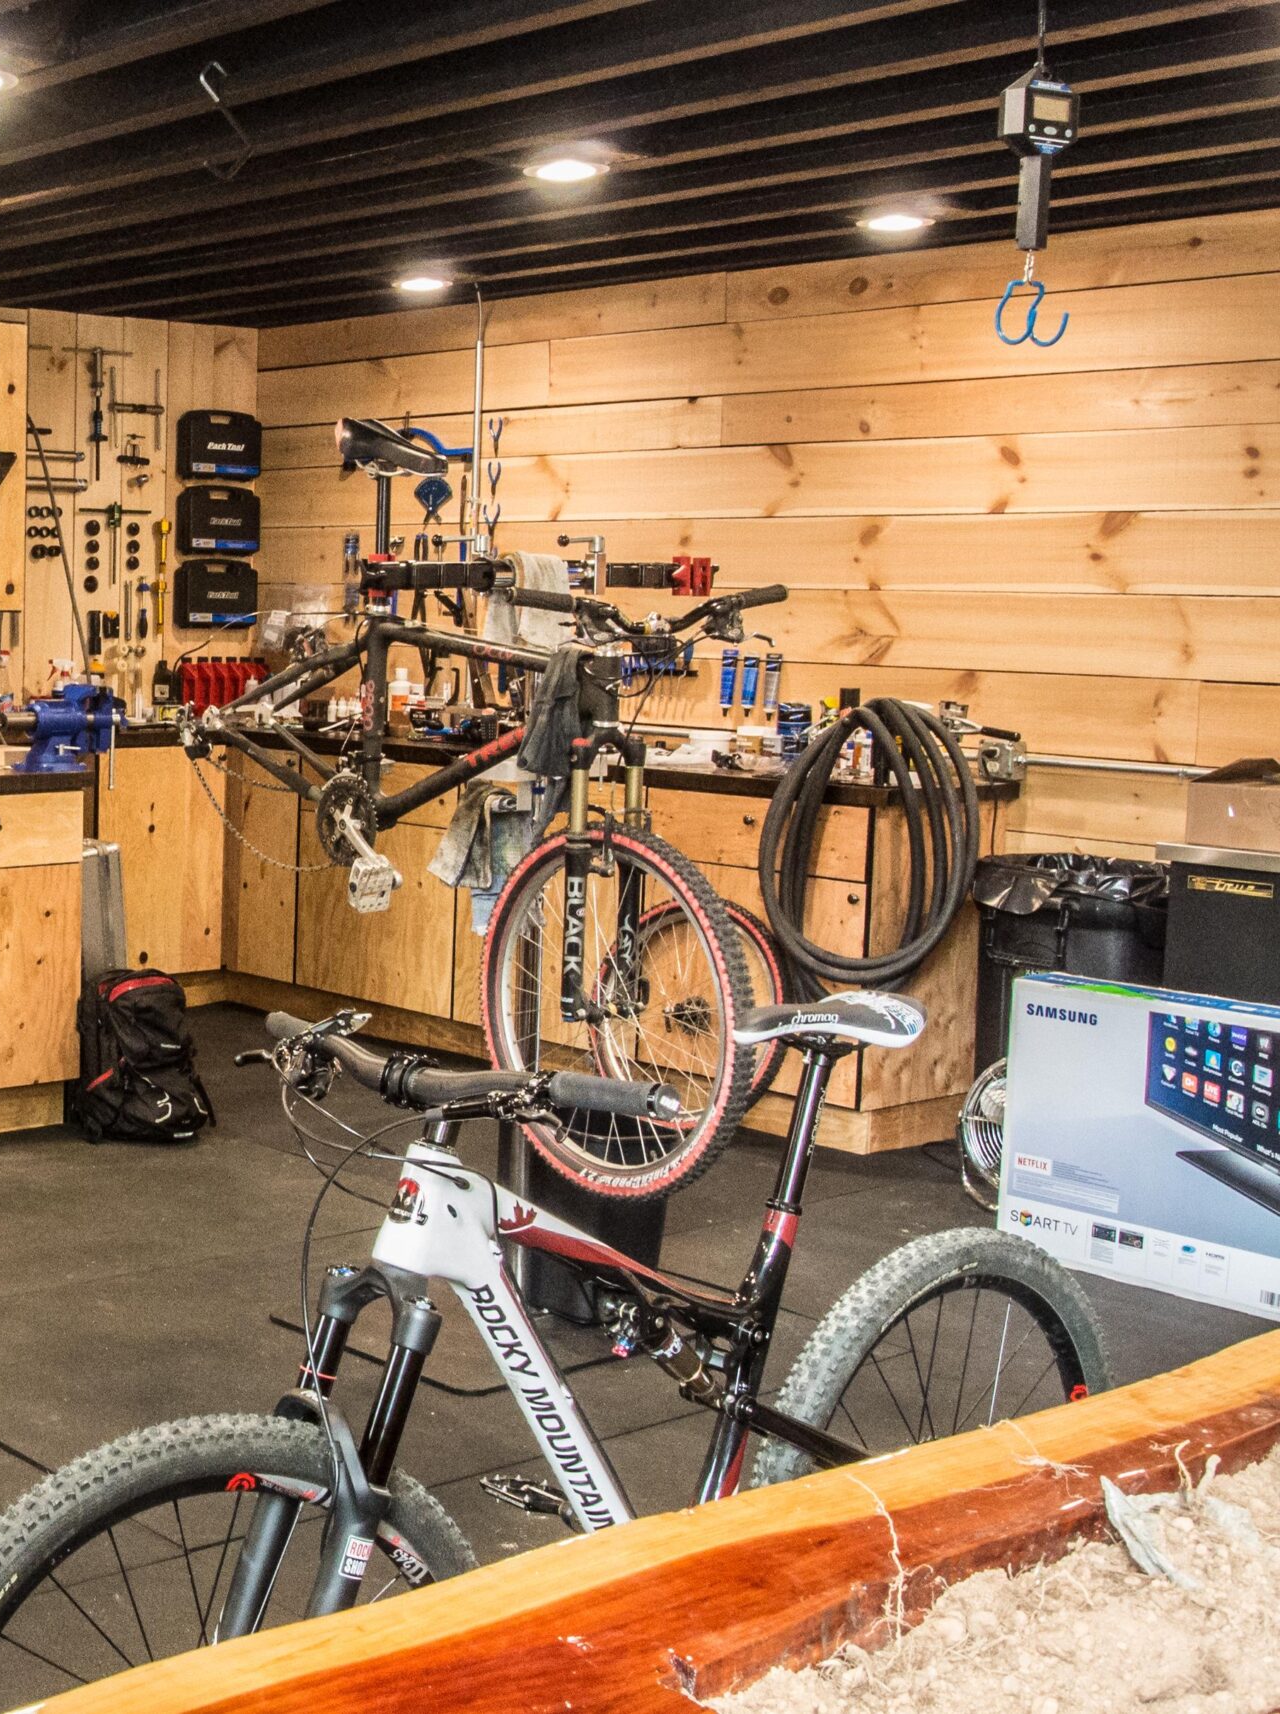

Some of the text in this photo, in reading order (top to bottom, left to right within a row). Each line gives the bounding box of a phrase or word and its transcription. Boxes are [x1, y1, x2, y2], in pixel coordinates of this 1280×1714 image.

[564, 875, 589, 974] BLACK
[790, 1009, 839, 1025] chromag
[1026, 1002, 1098, 1026] SAMSUNG
[1017, 1156, 1048, 1171] NETFLIX
[1009, 1209, 1080, 1237] SART TV
[471, 1283, 540, 1379] ROCKY
[343, 1557, 367, 1576] SHO
